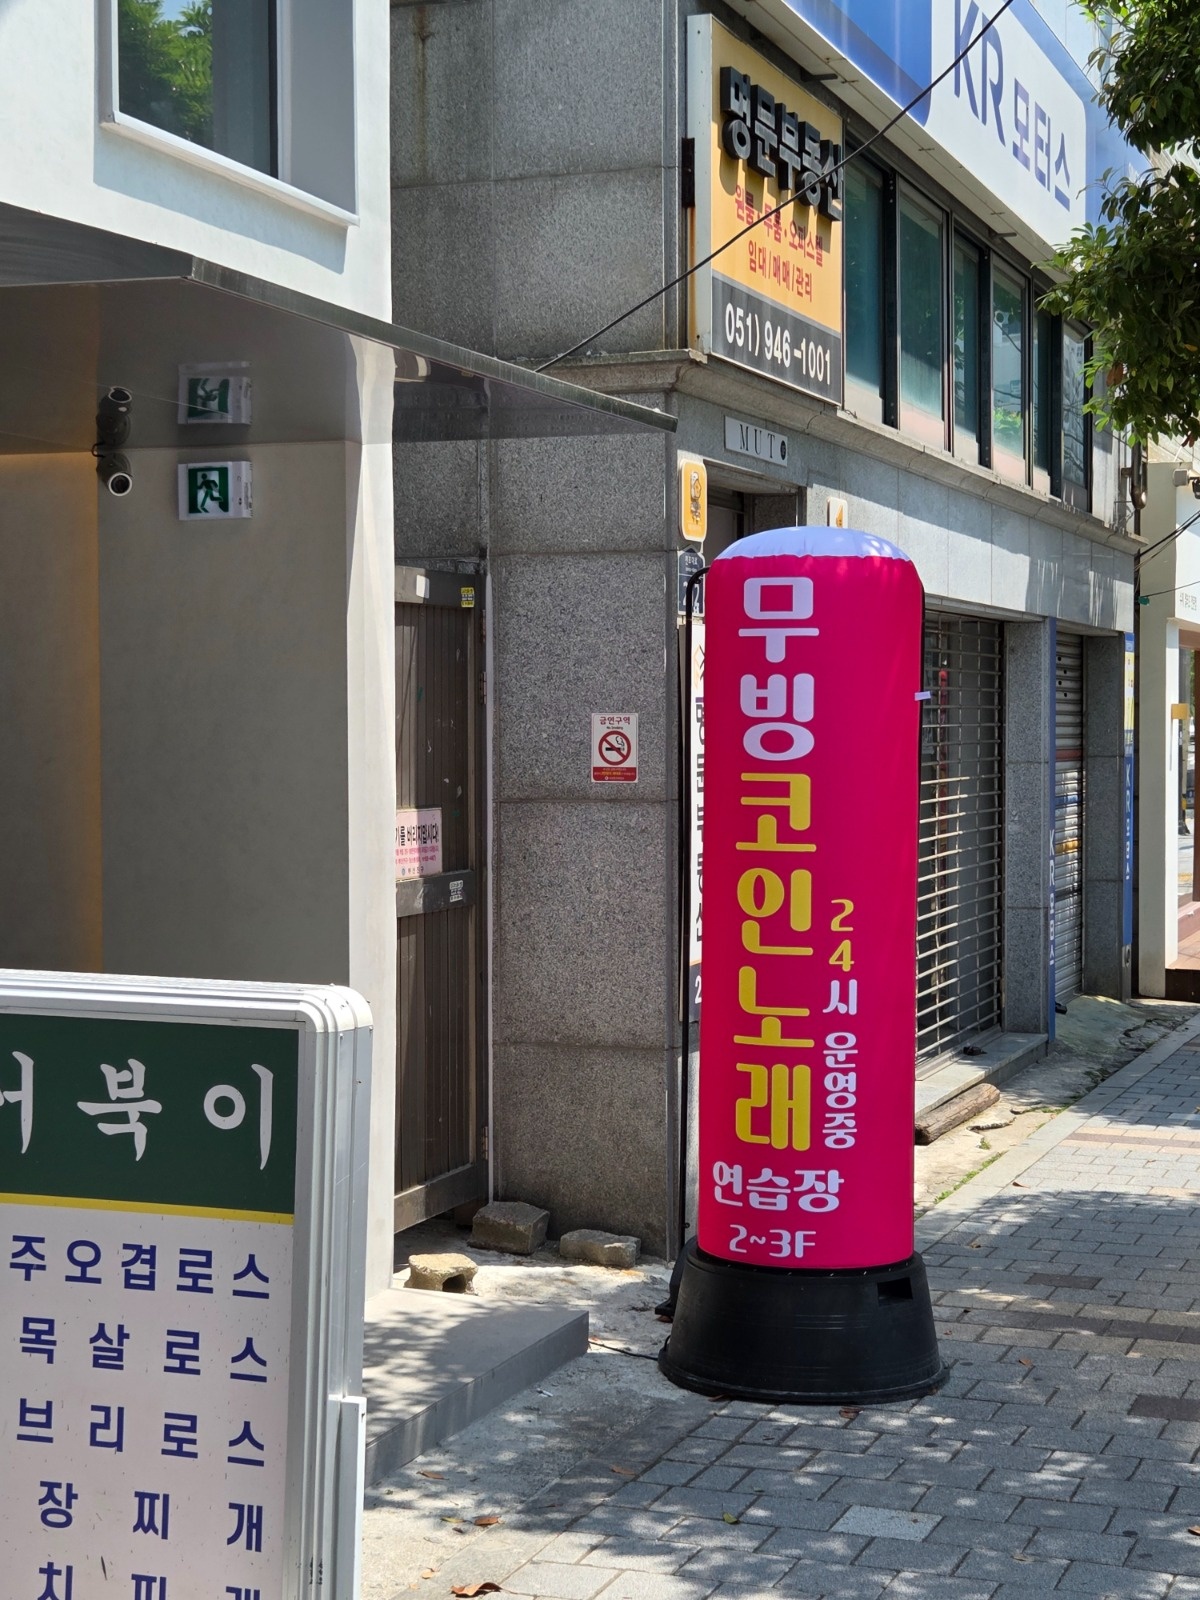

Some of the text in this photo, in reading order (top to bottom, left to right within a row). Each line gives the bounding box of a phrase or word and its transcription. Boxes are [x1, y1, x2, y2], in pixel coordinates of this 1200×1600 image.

[720, 66, 843, 221] 명문부동산
[599, 716, 631, 726] 금연구역
[712, 1160, 845, 1214] 연습장
[728, 1224, 817, 1259] 2~3F
